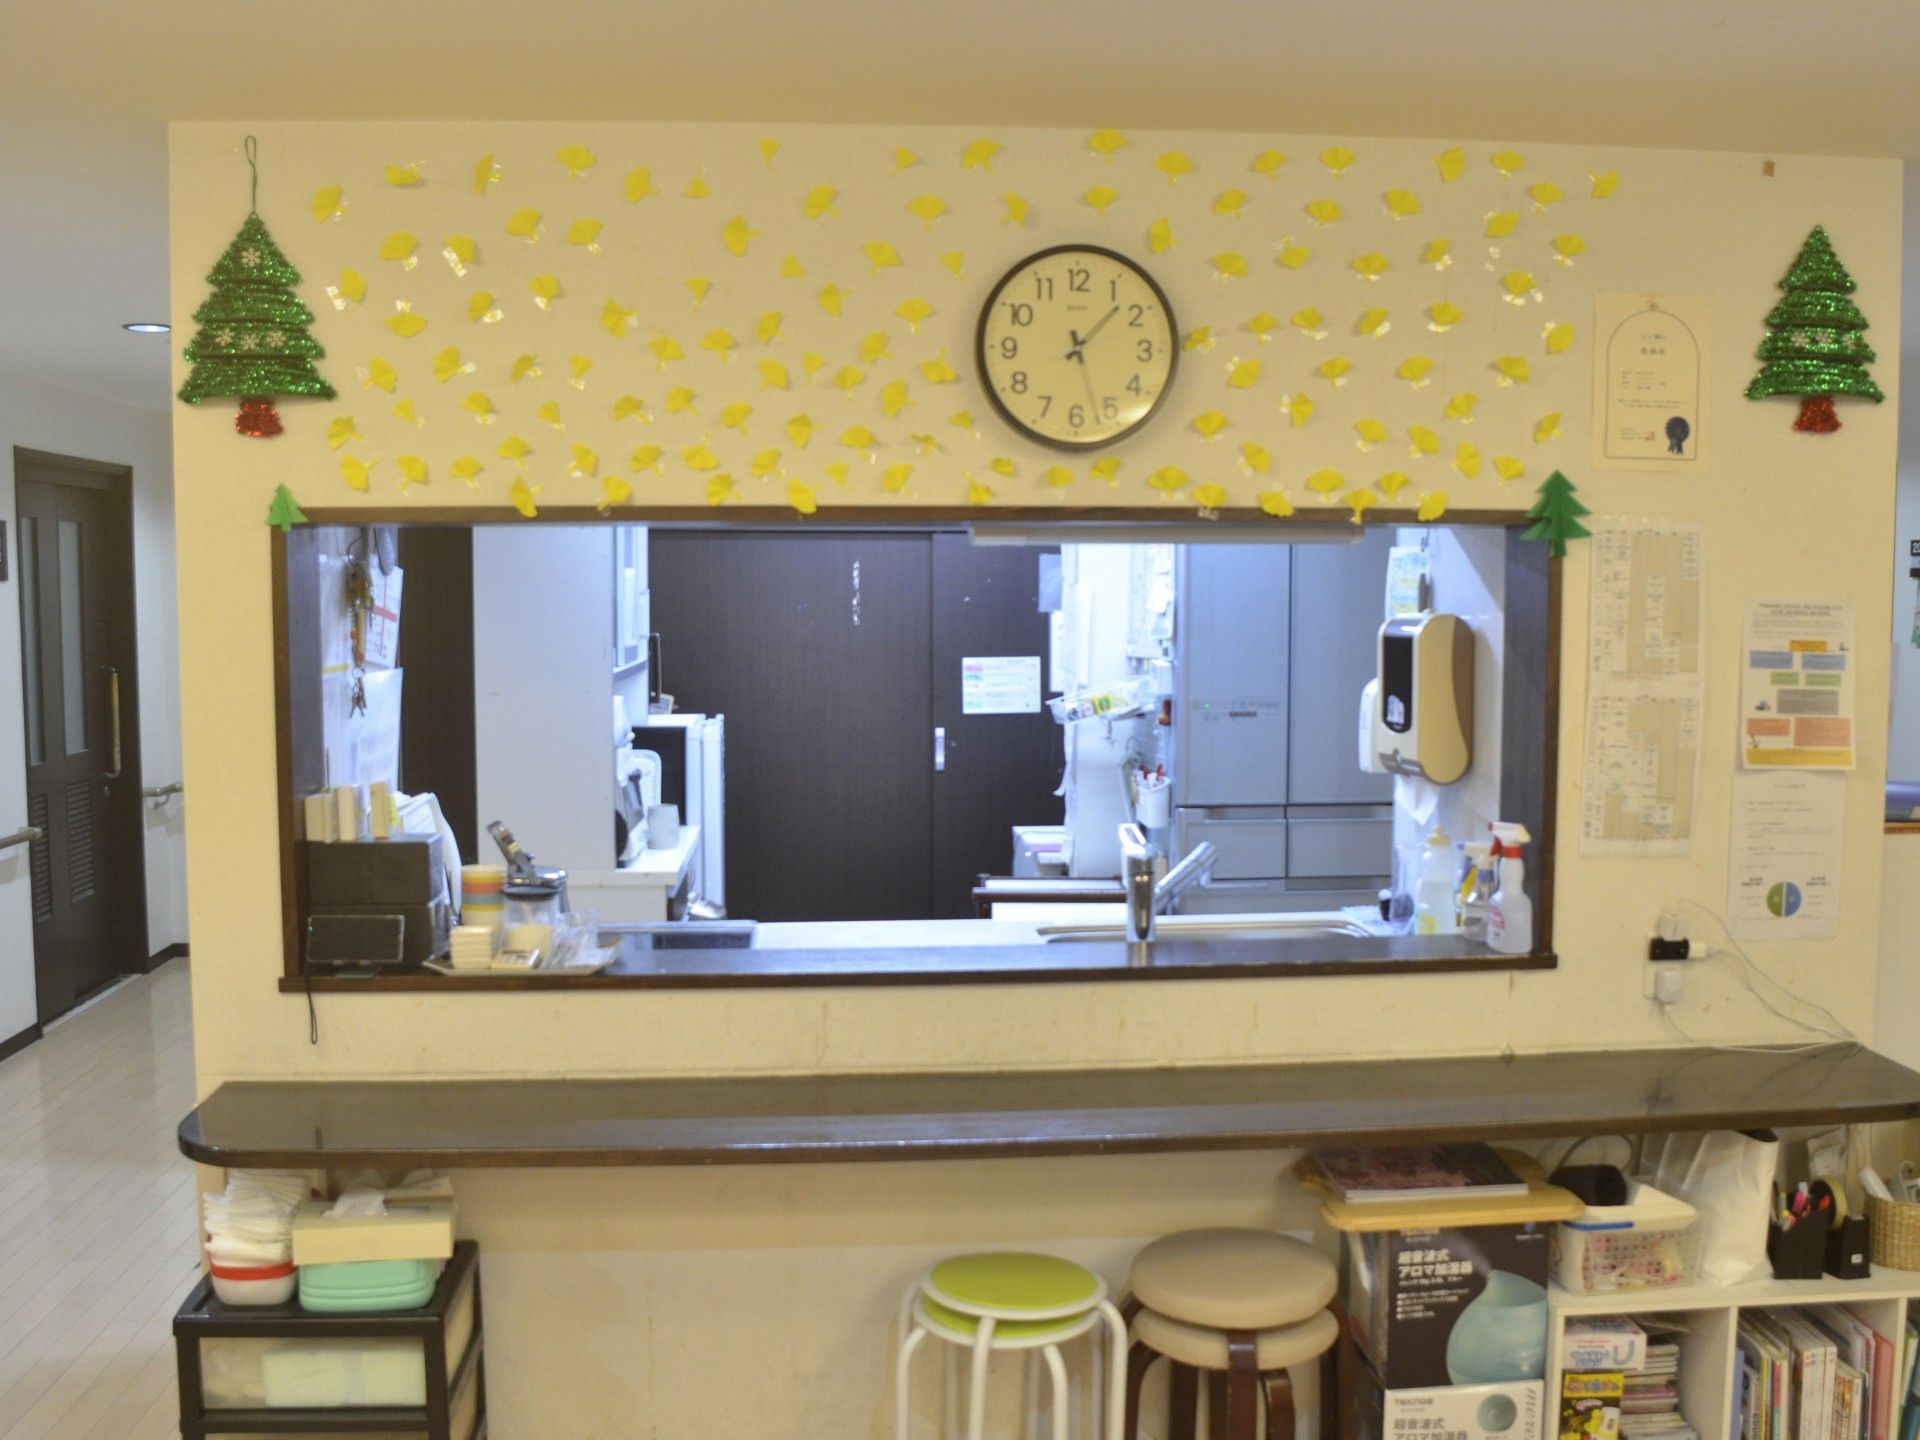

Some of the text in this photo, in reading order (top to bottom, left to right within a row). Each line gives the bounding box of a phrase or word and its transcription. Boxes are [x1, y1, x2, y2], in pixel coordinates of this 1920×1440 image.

[1036, 278, 1053, 300] 11
[1068, 269, 1090, 292] 12
[1110, 280, 1117, 302] 1
[1009, 303, 1033, 327] 10
[1128, 304, 1144, 327] 2
[1001, 336, 1018, 360] 9
[1136, 339, 1153, 362] 3
[1010, 371, 1028, 394] 8
[1125, 373, 1142, 397] 4
[1037, 396, 1053, 418] 7
[1068, 405, 1085, 428] 6
[1103, 397, 1118, 420] 5
